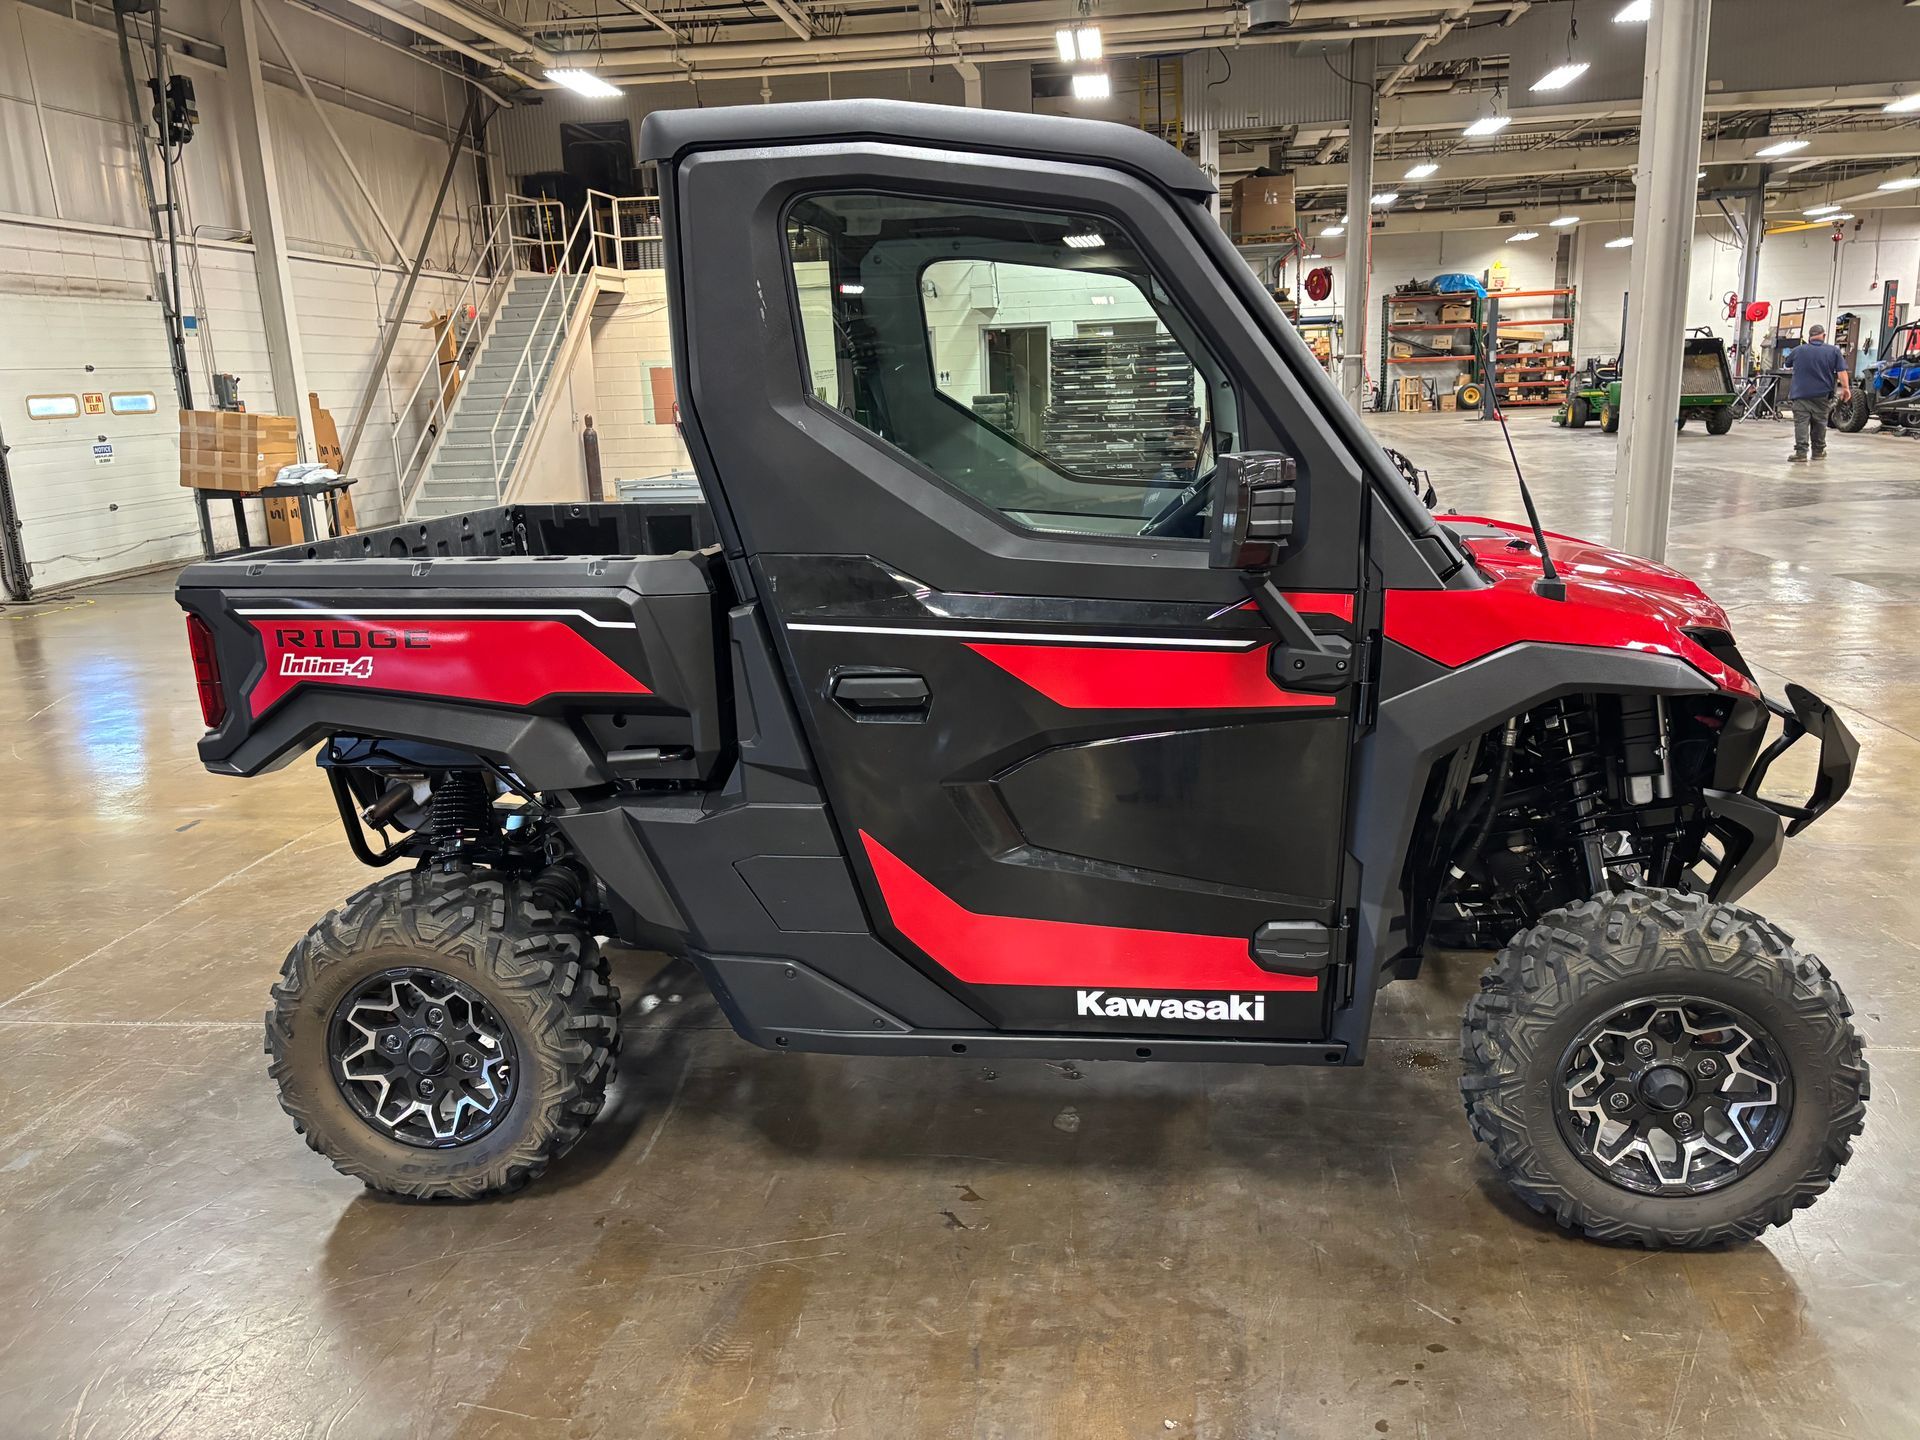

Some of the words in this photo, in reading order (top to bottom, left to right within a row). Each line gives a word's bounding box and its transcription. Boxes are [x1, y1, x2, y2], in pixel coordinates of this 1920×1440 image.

[1888, 296, 1896, 327] STRATUS
[85, 396, 94, 404] NOT
[95, 395, 102, 403] AN
[89, 404, 100, 412] EXIT
[95, 446, 111, 454] NOTICE
[275, 629, 431, 649] RIDGE
[279, 653, 374, 679] Inline-4
[1076, 990, 1265, 1021] Kawasaki
